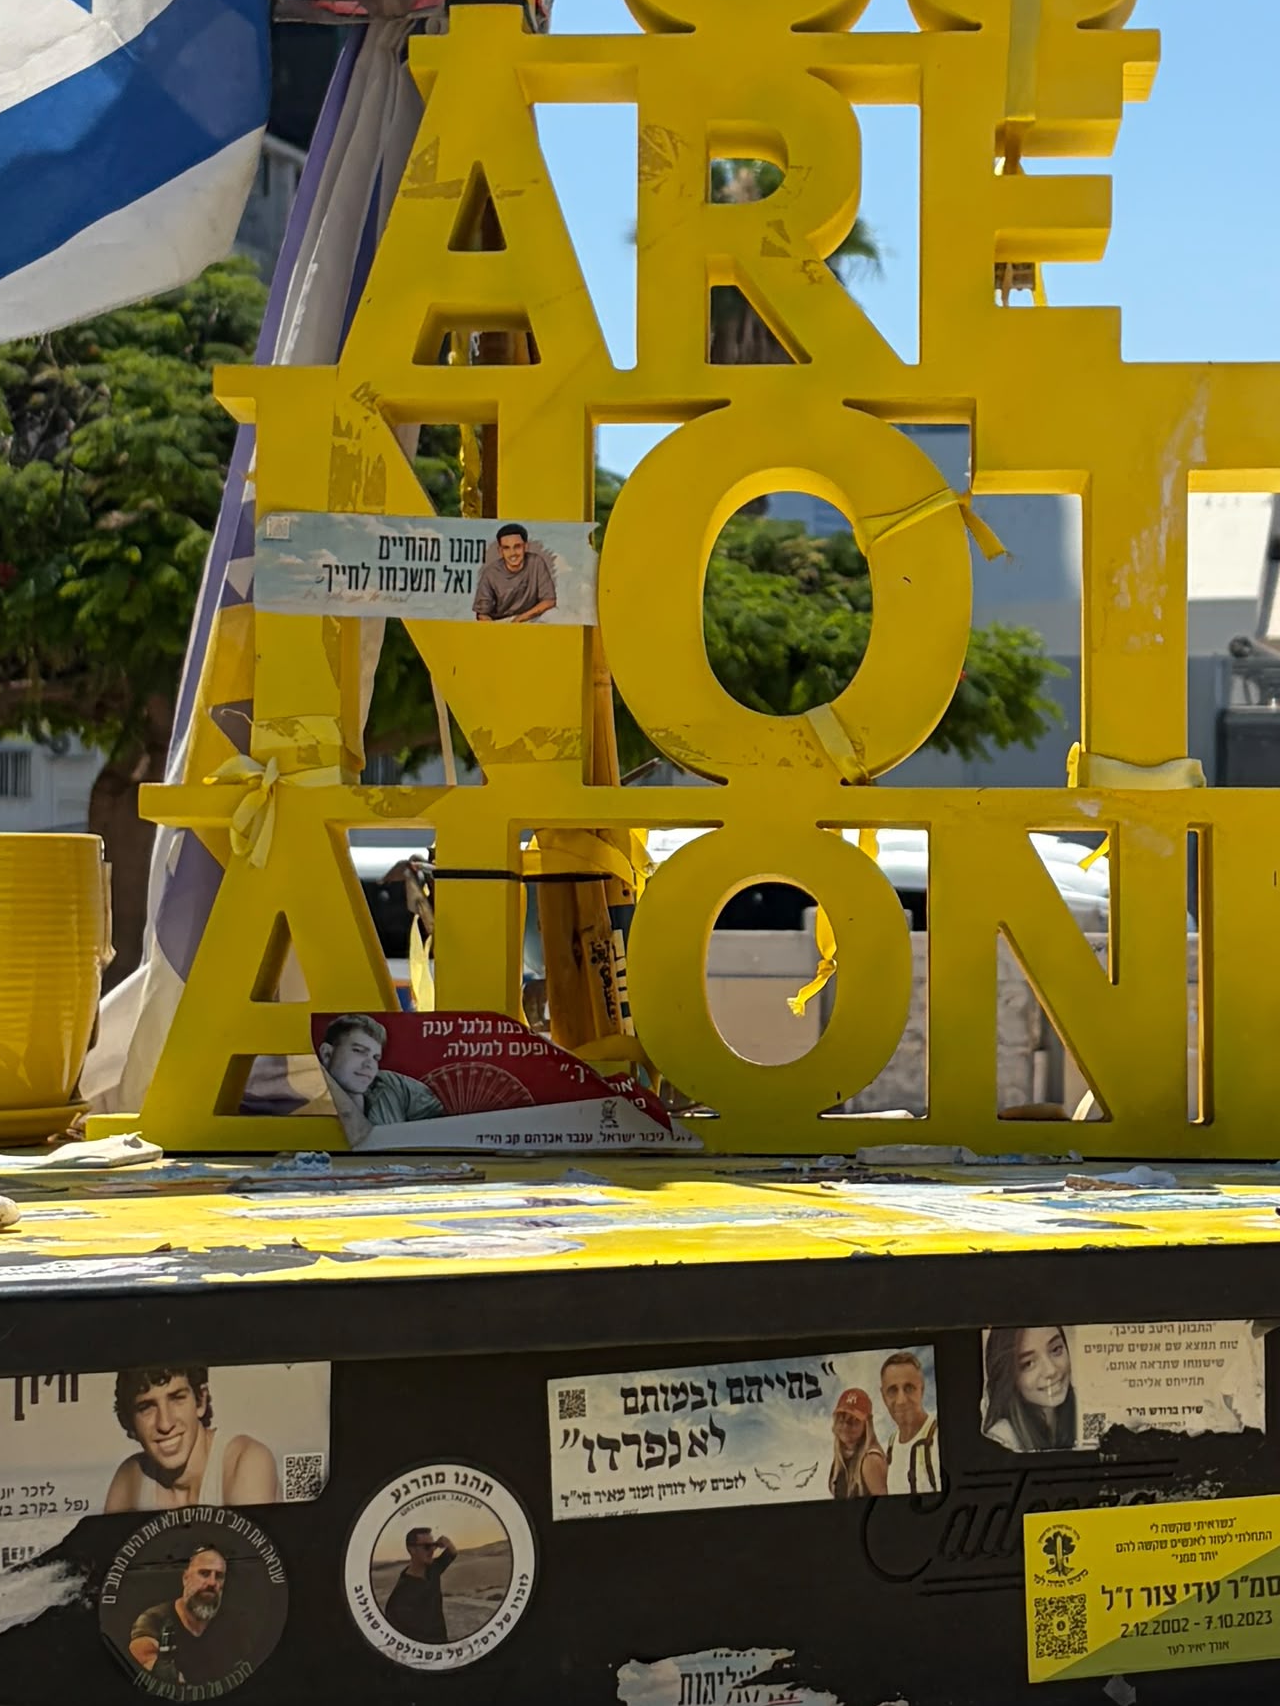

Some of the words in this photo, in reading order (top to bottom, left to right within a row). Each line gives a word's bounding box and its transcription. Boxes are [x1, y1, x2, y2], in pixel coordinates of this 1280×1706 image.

[340, 30, 1161, 368] ARE
[378, 535, 440, 562] מהחיים
[449, 538, 486, 564] תהנו
[322, 562, 370, 593] לחייך
[378, 566, 435, 593] תשכחו
[443, 565, 472, 593] ואל
[422, 1020, 454, 1038] ענק
[458, 1017, 493, 1035] גלגל
[723, 1360, 837, 1405] "בחייהם
[620, 1379, 718, 1415] ובמותם
[688, 1413, 726, 1457] לא
[560, 1427, 681, 1473] נפרדו"
[21, 1481, 55, 1497] לזכר
[390, 1471, 446, 1503] מהרגע
[454, 1472, 494, 1497] תהנו
[19, 1502, 58, 1519] בקרב
[64, 1497, 88, 1511] נפל
[1102, 1584, 1134, 1611] ז"ל
[1140, 1587, 1177, 1608] צור
[1183, 1581, 1221, 1605] עדי
[1120, 1618, 1189, 1639] 2.12.2002
[1205, 1610, 1273, 1630] 7.10.2023
